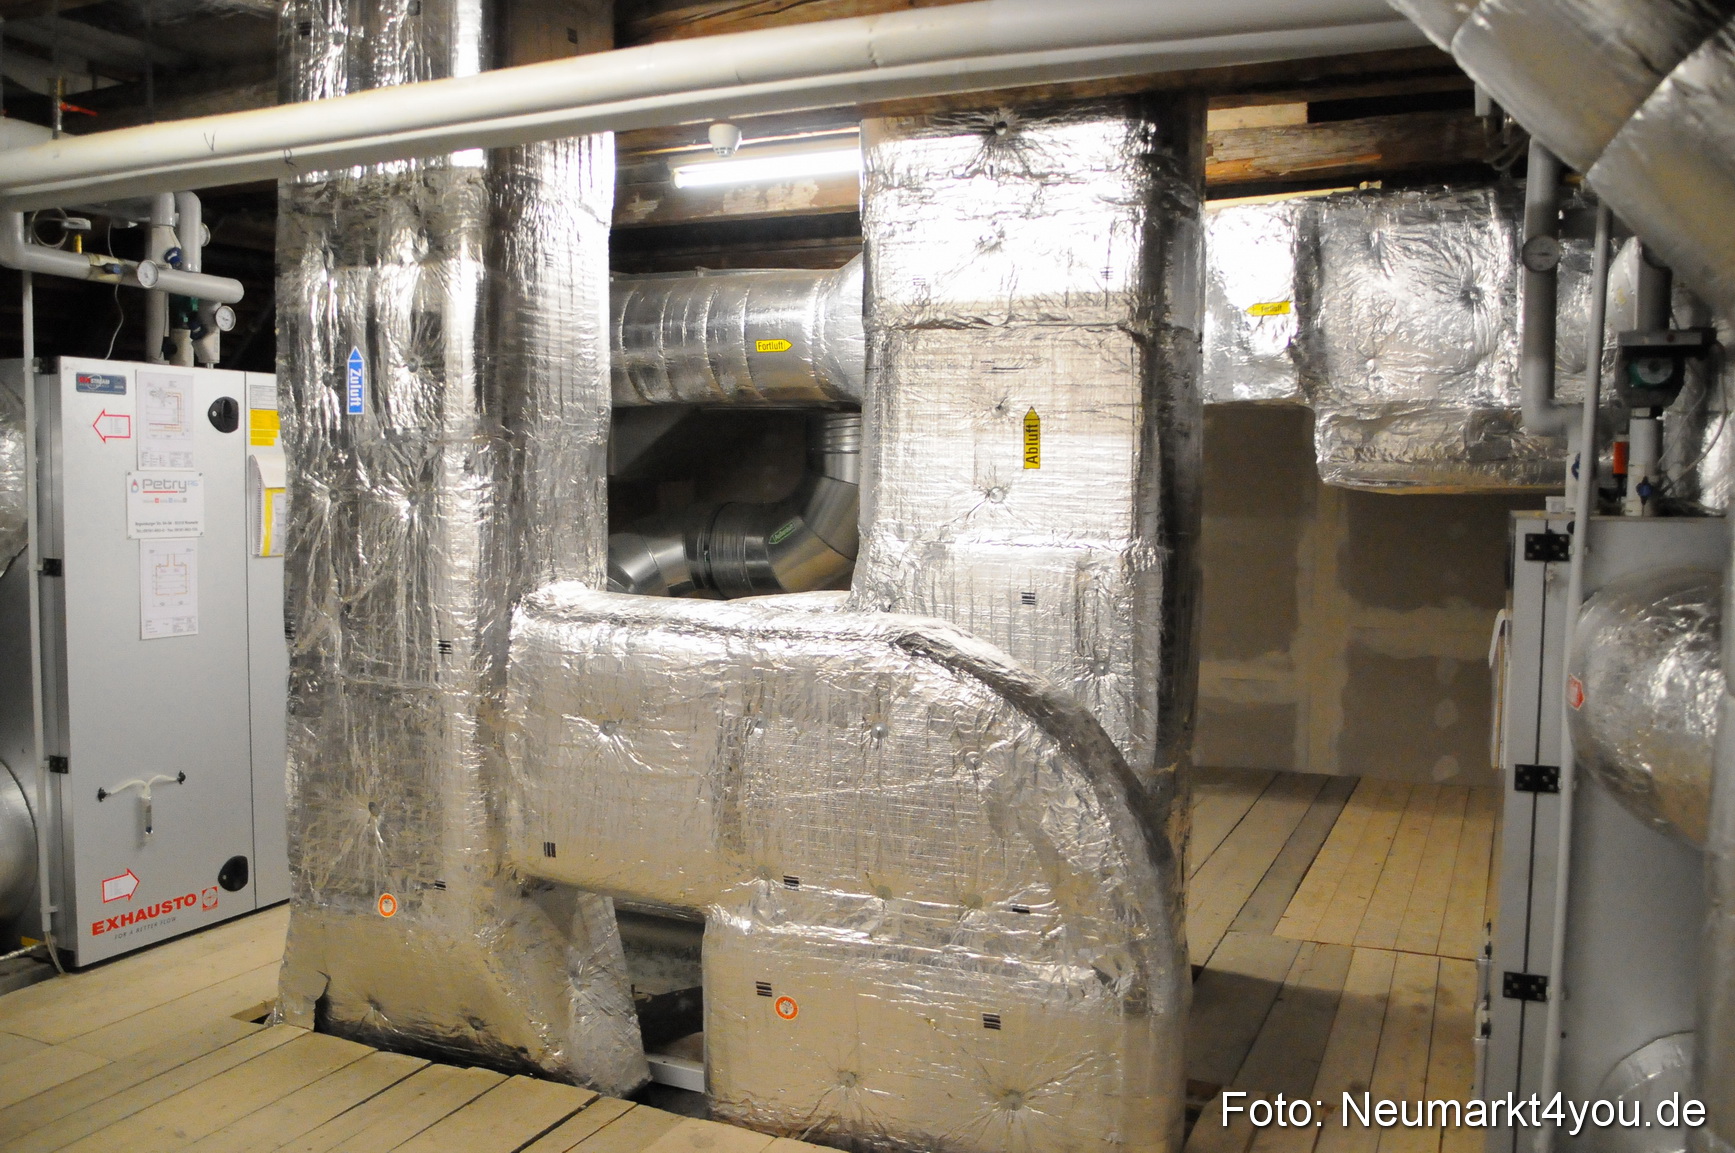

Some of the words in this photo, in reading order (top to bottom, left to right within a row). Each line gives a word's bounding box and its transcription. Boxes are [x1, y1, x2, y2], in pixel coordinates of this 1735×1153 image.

[757, 341, 784, 351] Fortluft
[350, 368, 362, 407] Zuluft
[1026, 424, 1038, 465] Abluft
[142, 478, 187, 494] Petry
[92, 893, 197, 936] EXHAUSTO
[114, 932, 127, 940] FOR
[136, 921, 158, 934] BETTER
[160, 916, 177, 926] FLOW
